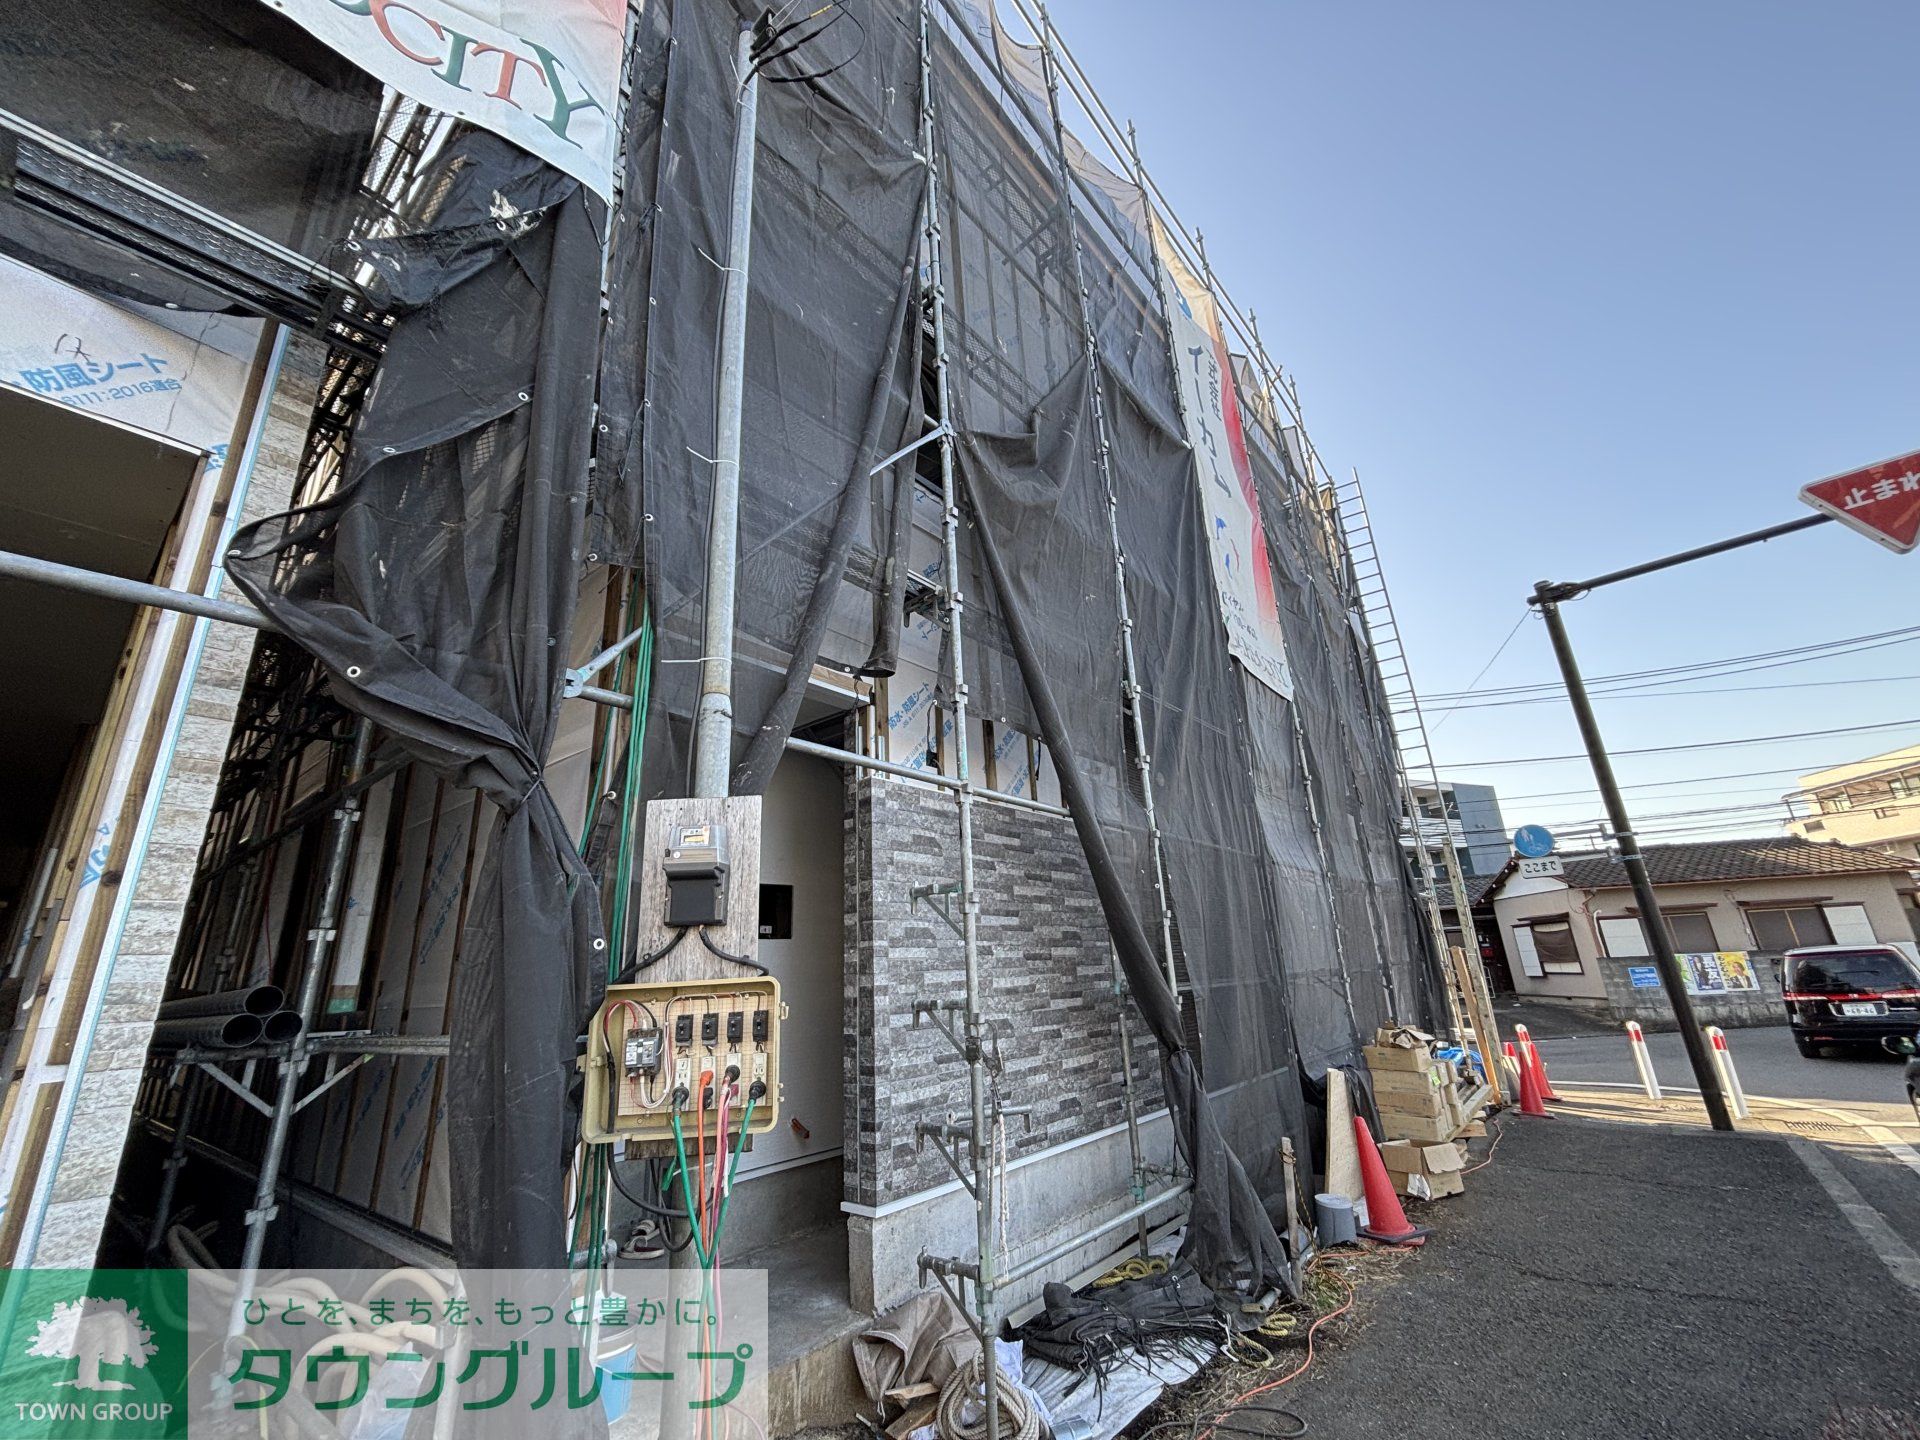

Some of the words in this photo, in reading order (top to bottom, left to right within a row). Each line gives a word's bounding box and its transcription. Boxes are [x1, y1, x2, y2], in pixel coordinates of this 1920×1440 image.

[1843, 471, 1920, 510] 止まれ
[1525, 861, 1557, 873] ここまで
